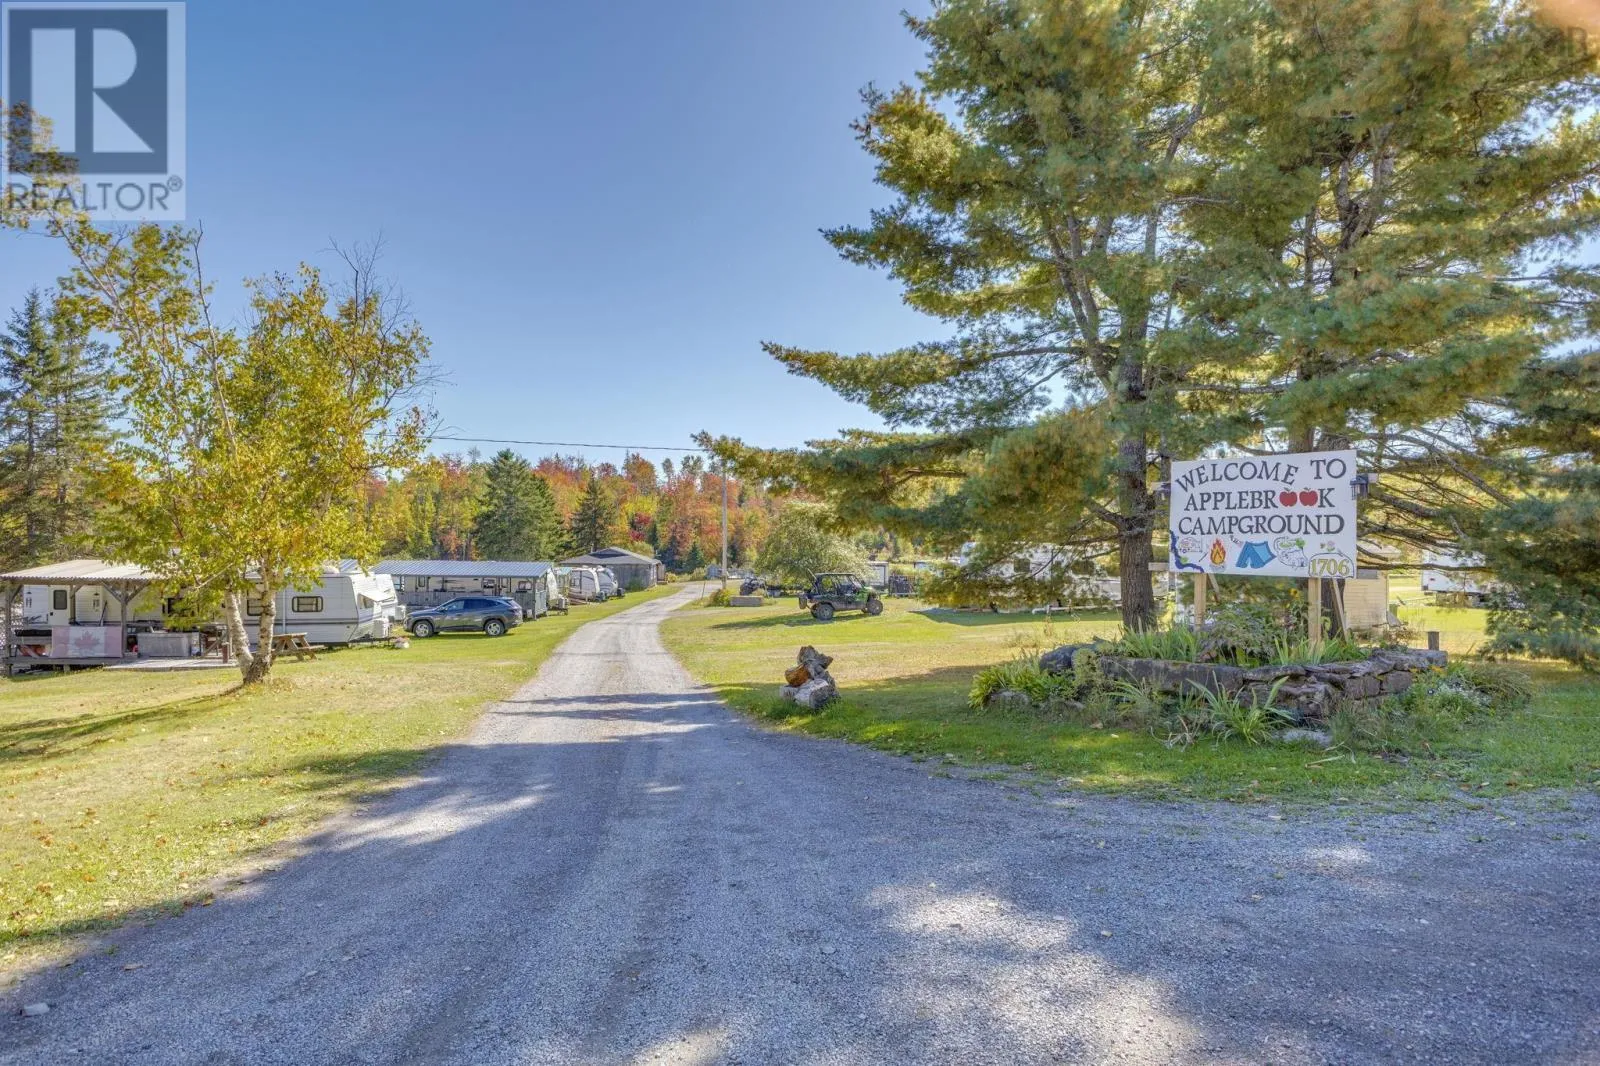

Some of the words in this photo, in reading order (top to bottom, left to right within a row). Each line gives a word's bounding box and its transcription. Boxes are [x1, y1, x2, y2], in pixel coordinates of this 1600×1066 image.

[1176, 461, 1298, 493] WELCOME
[1310, 458, 1347, 480] TO
[1178, 514, 1344, 535] CAMPGROUND
[1311, 558, 1350, 577] 1706
